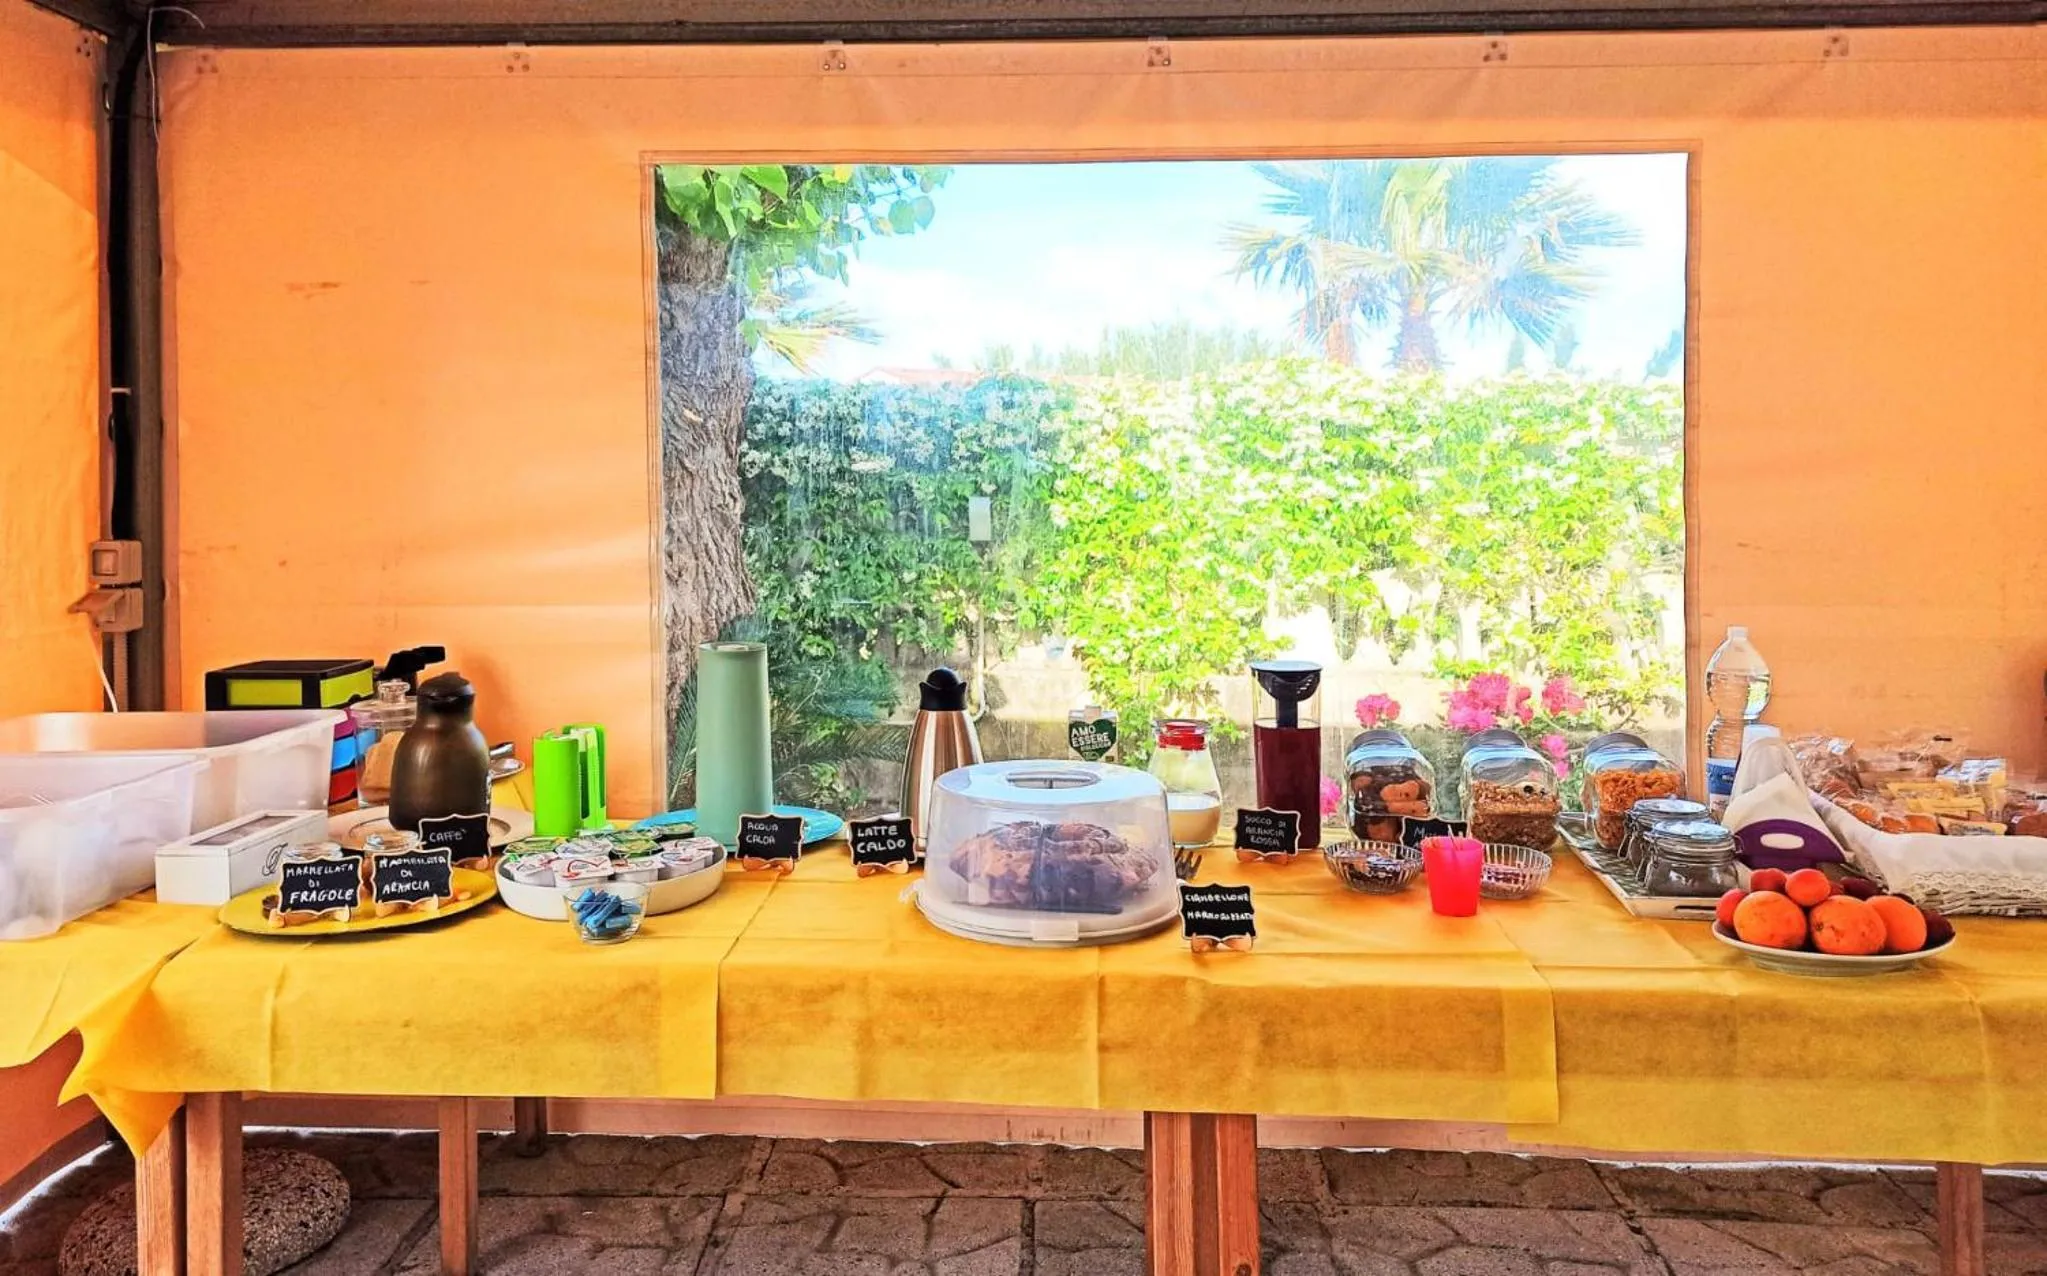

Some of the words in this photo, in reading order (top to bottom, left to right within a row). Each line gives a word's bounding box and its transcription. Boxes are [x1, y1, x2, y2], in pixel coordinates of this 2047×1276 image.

[1071, 725, 1096, 738] AMO
[1071, 732, 1110, 747] ESSERE
[747, 821, 779, 832] ACQUA
[857, 825, 898, 837] LATTE
[745, 834, 775, 845] CALDA
[856, 839, 906, 853] CALDO
[379, 856, 446, 868] MARMELLATA
[286, 863, 354, 878] MARMELLATA
[400, 869, 413, 877] DI
[308, 879, 320, 888] DI
[382, 880, 430, 894] ARANCIA
[289, 888, 354, 904] FRAGOLE
